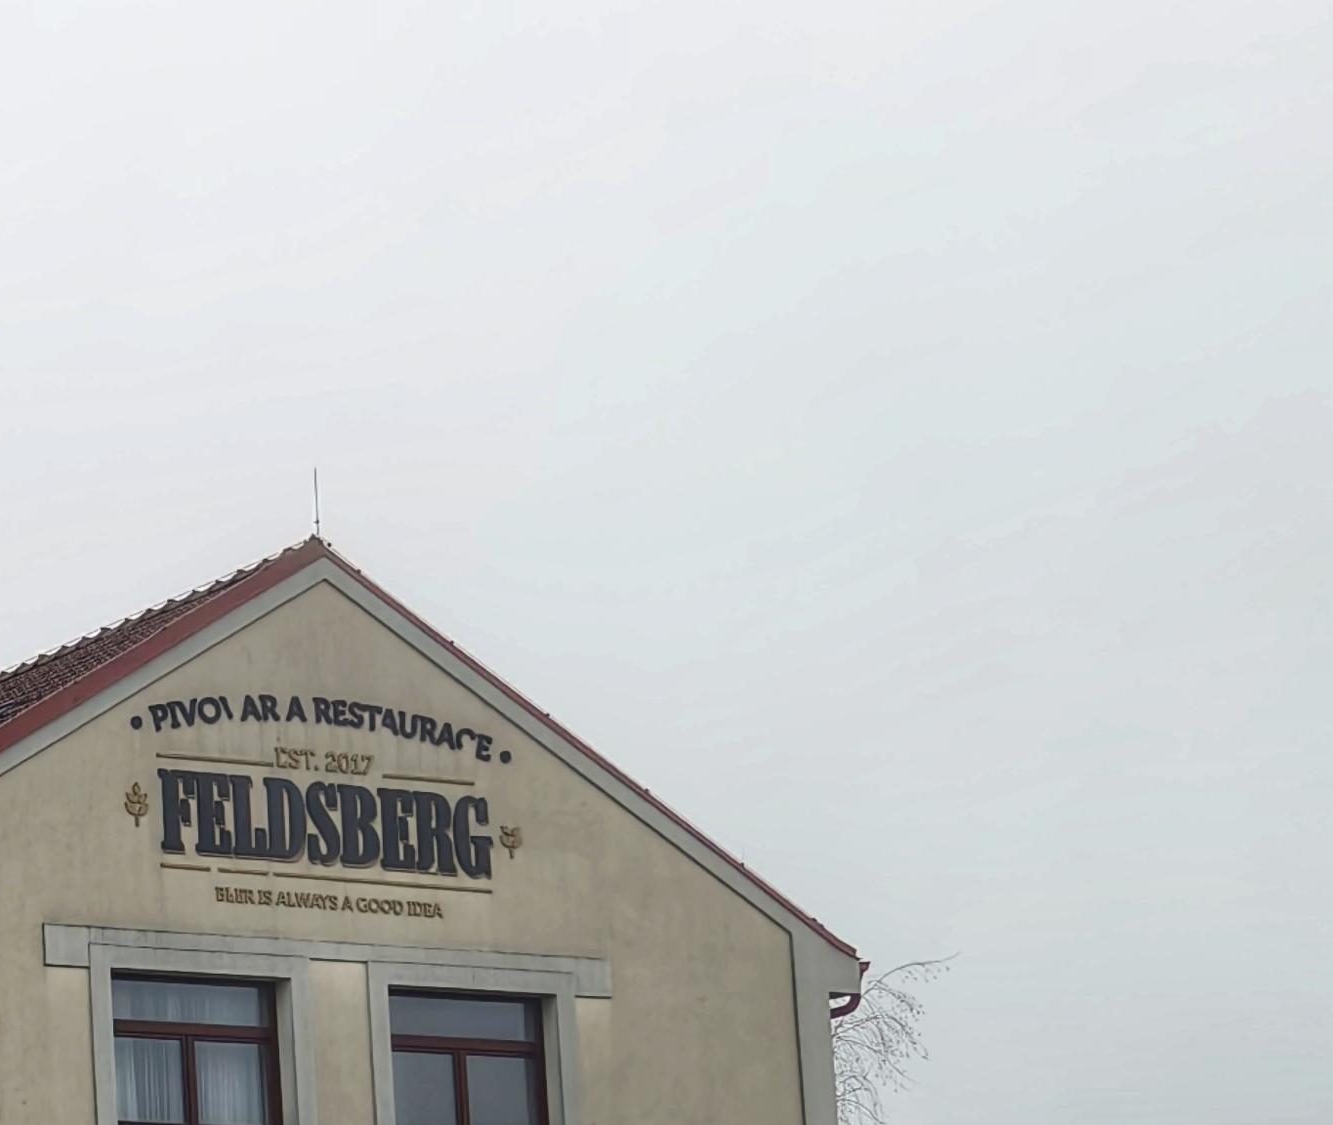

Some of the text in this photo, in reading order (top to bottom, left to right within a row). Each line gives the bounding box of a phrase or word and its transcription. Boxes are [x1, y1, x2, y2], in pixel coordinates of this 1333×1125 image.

[286, 696, 308, 723] A
[312, 697, 494, 763] RESTAURACE
[324, 750, 375, 776] 2017
[157, 768, 494, 880] FELDSBERG
[257, 889, 273, 906] IS
[275, 891, 338, 912] ALWAYS
[341, 896, 354, 913] A
[356, 897, 405, 917] GOOD
[407, 900, 444, 919] IDEA
